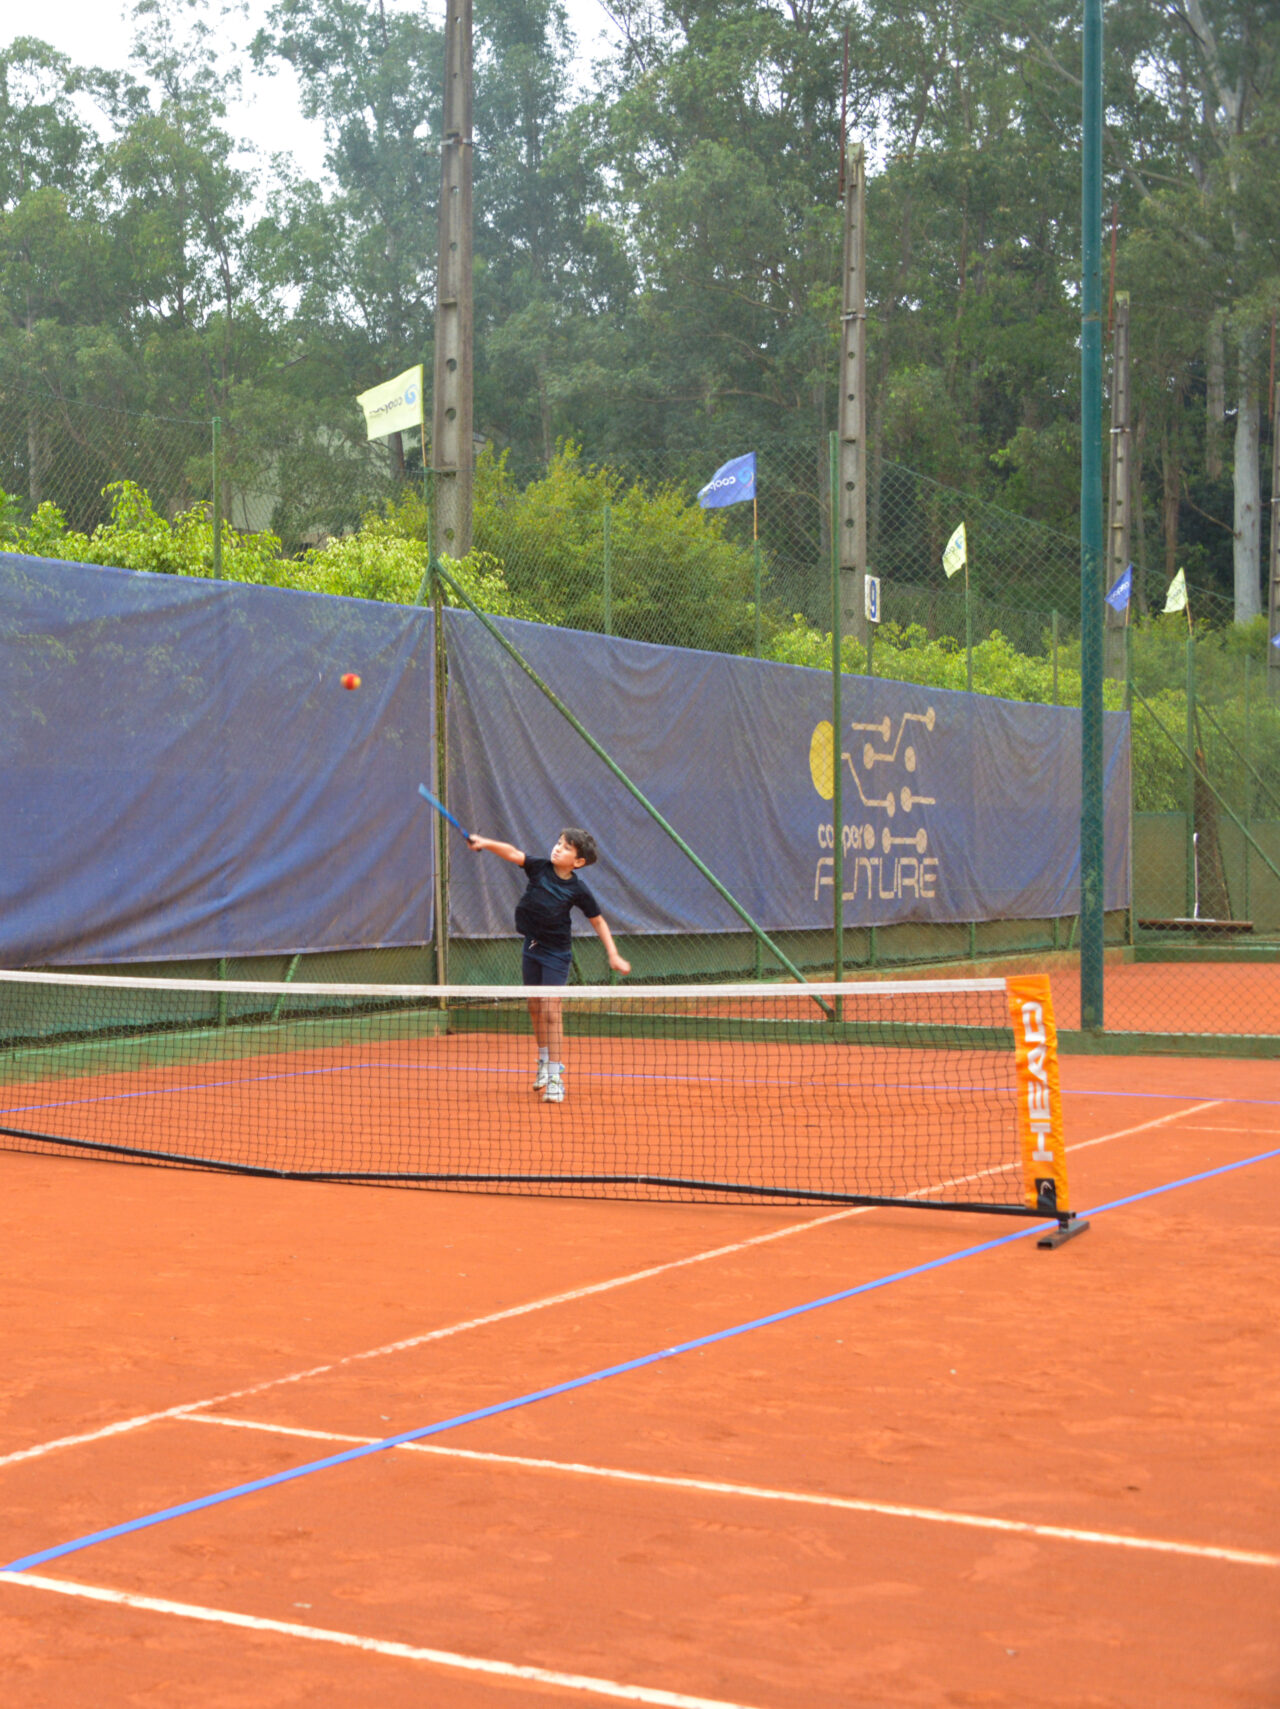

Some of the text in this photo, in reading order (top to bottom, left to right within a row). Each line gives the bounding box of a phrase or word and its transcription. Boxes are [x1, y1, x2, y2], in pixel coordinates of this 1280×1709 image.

[870, 579, 877, 619] 9
[818, 823, 864, 858] coper
[1021, 1001, 1054, 1162] HEAD
